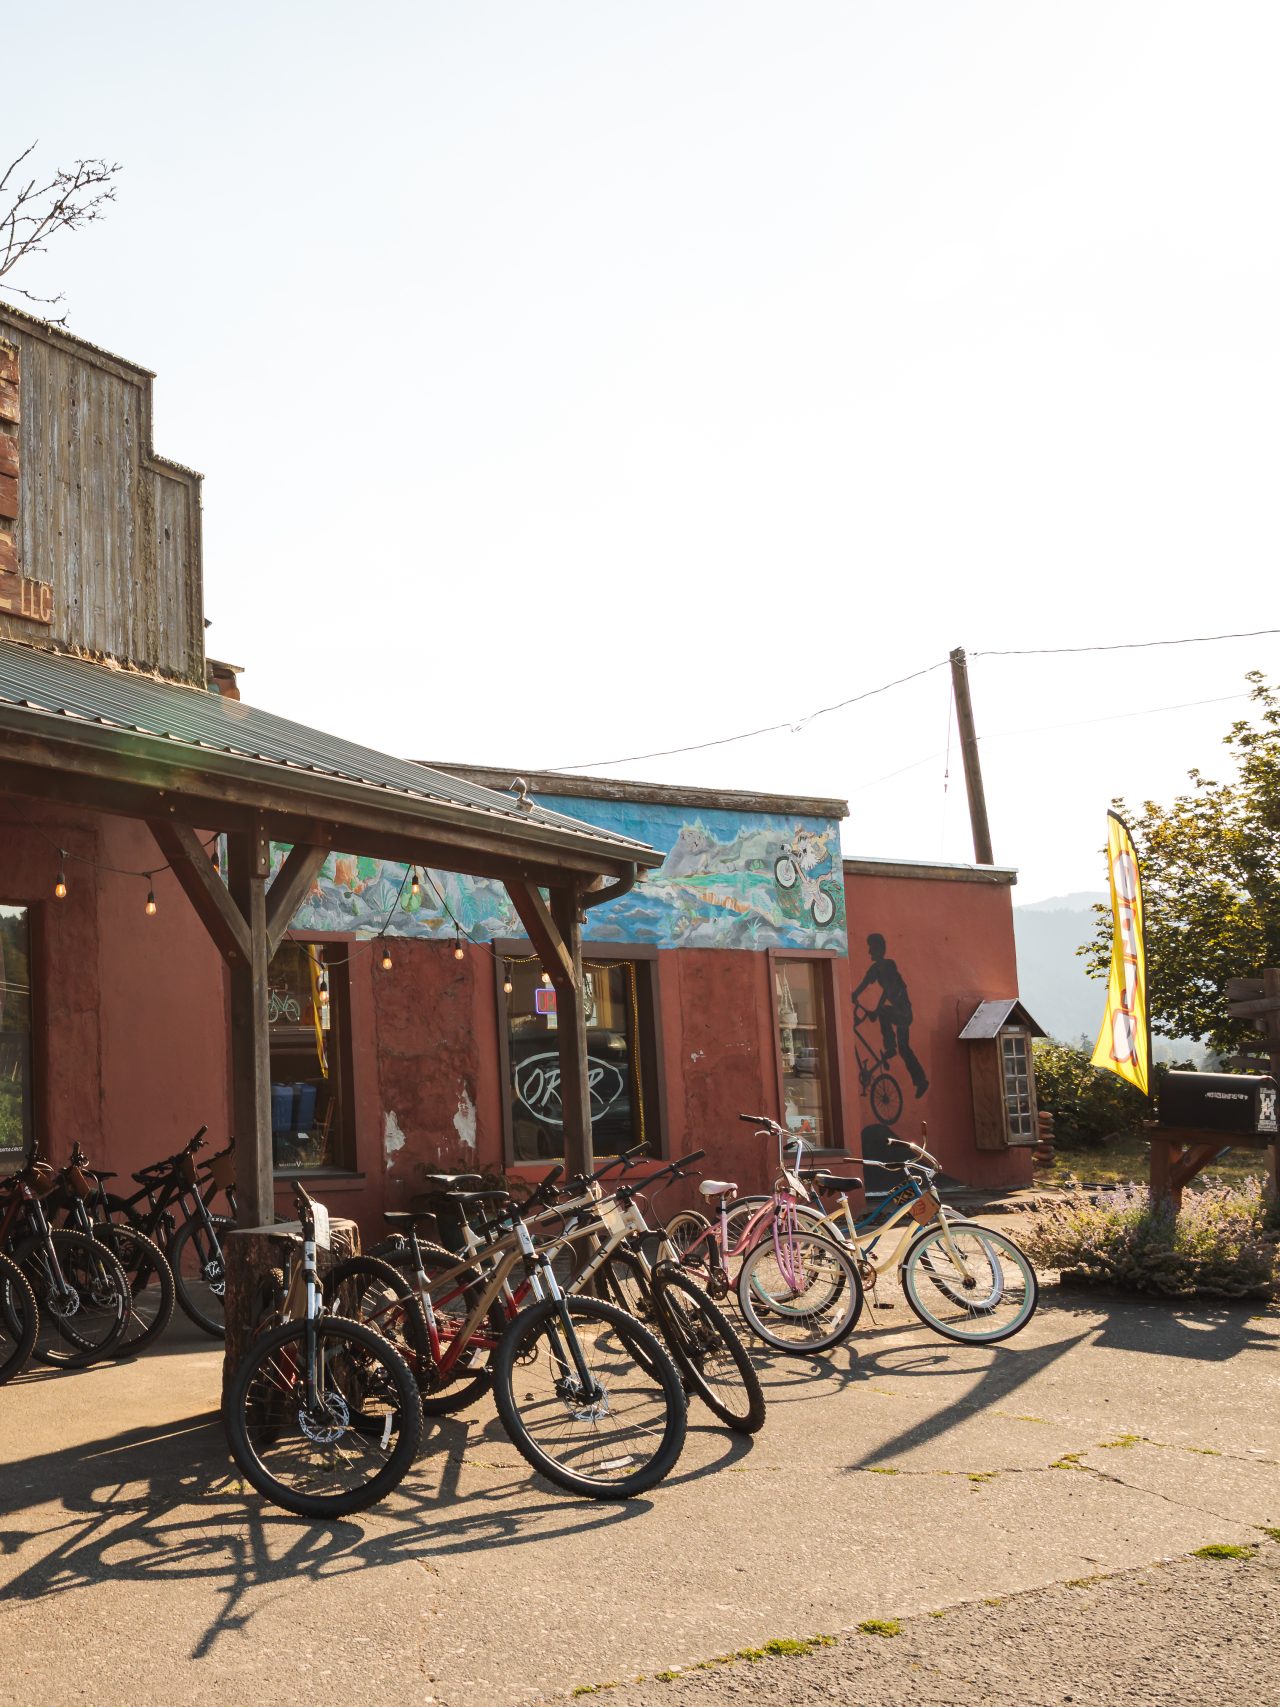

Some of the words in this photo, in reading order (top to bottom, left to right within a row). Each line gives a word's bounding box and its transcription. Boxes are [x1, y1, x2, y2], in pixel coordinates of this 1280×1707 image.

[21, 580, 52, 622] LLC
[538, 991, 557, 1011] OP
[524, 1067, 605, 1107] ORR
